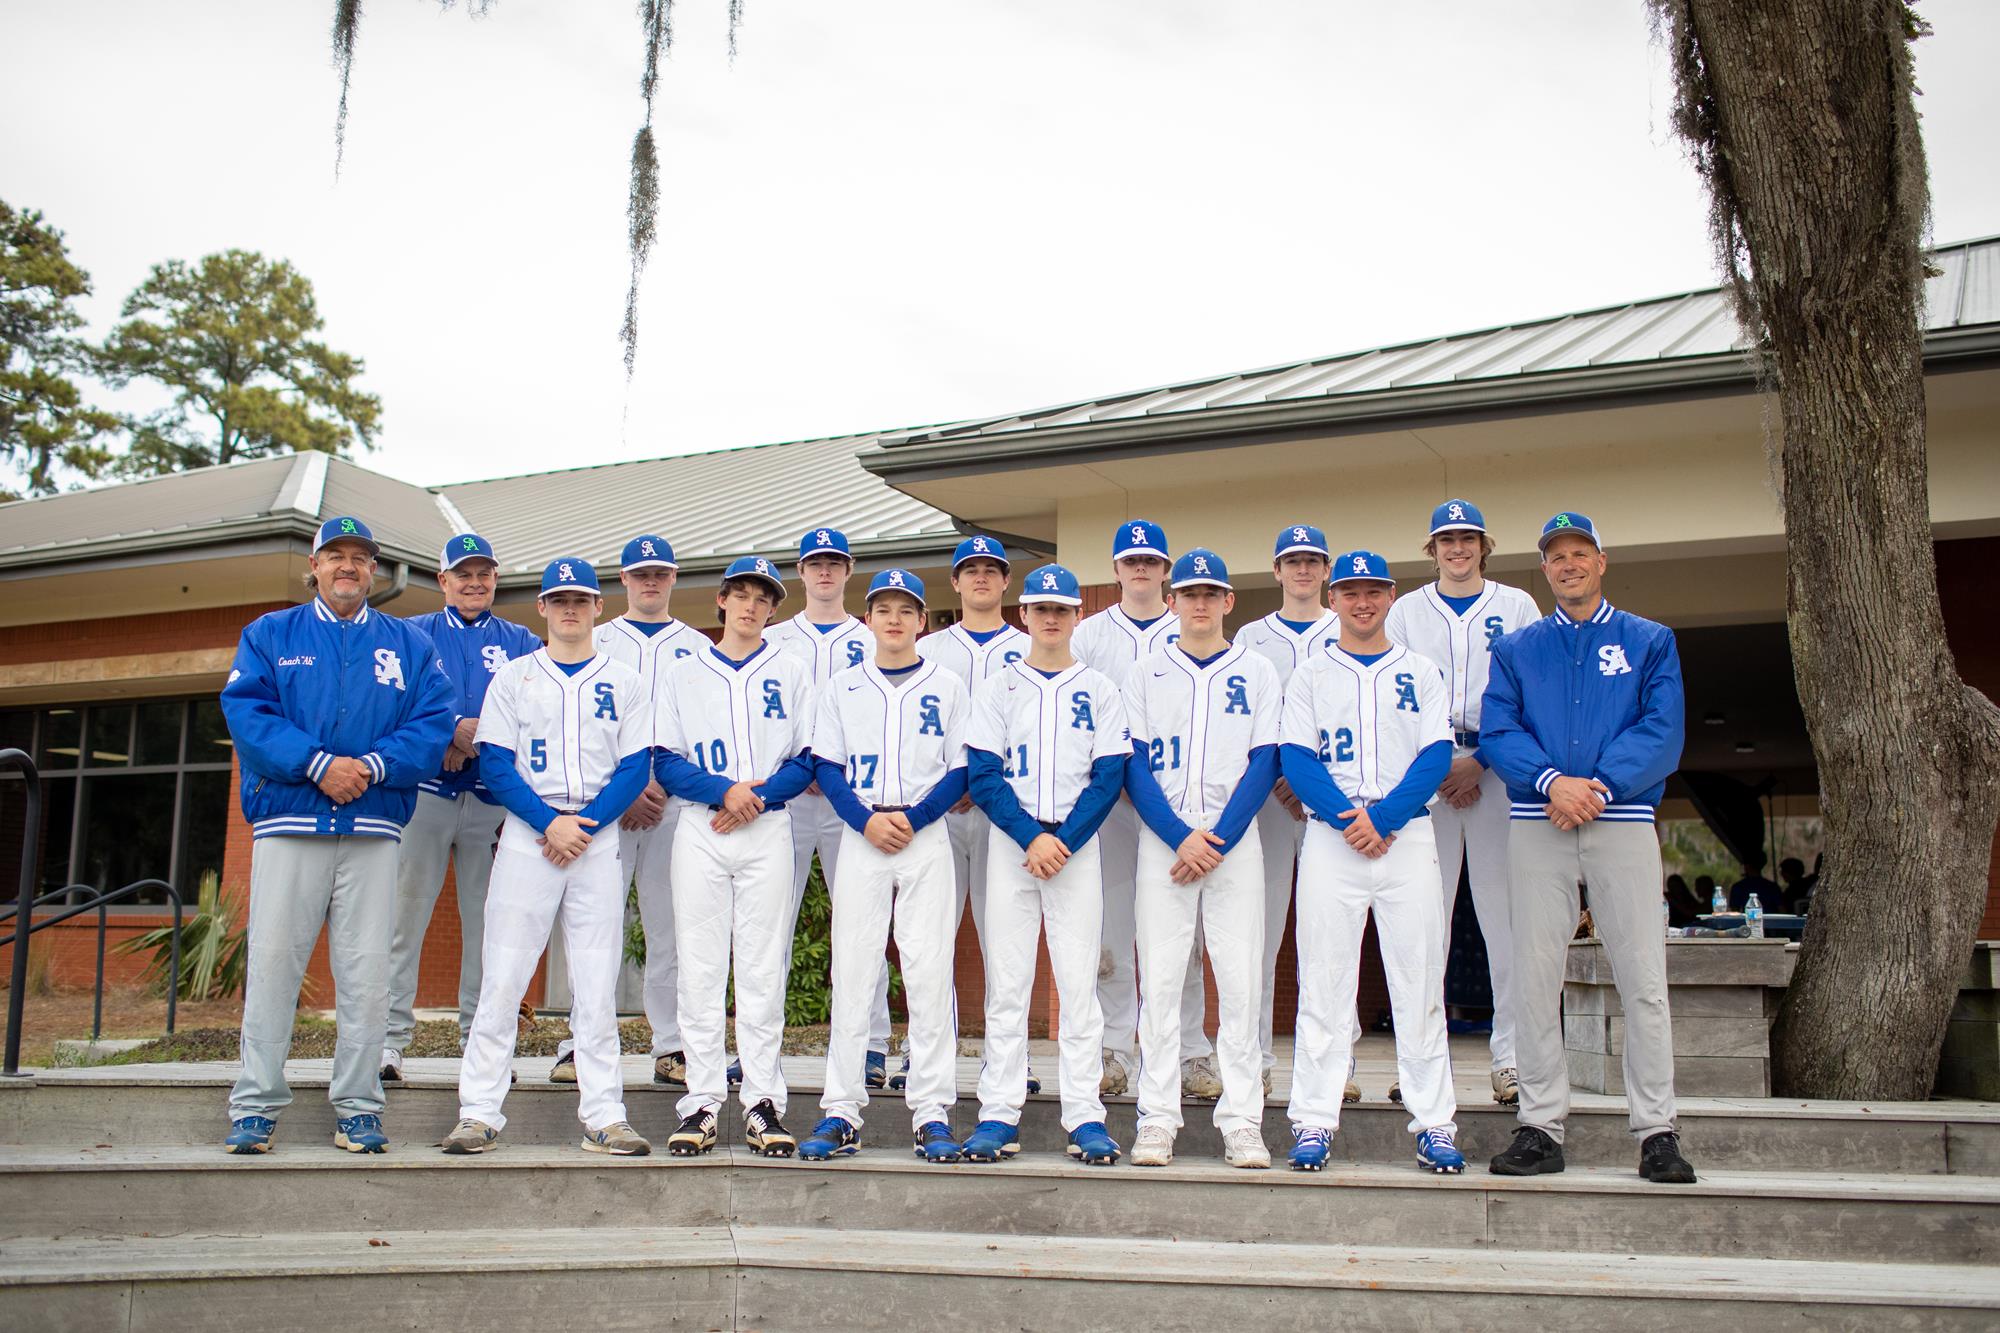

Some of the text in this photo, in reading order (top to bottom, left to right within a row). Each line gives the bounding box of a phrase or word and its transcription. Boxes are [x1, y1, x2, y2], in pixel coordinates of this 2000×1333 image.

[1448, 504, 1466, 521] SA
[1556, 513, 1573, 528] SA
[341, 518, 359, 534] SA
[1131, 526, 1149, 545] SA
[1293, 527, 1310, 542] SA
[463, 537, 480, 551] SA
[816, 530, 833, 546] SA
[973, 537, 990, 553] SA
[641, 540, 658, 557] SA
[559, 563, 577, 582] SA
[755, 558, 770, 576] SA
[1194, 556, 1211, 575] SA
[1352, 556, 1371, 575] SA
[889, 570, 906, 587] SA
[1042, 573, 1059, 591] SA
[278, 656, 301, 666] Coach
[374, 648, 406, 691] SA
[1598, 644, 1632, 676] SA
[594, 682, 618, 722] SA
[762, 679, 787, 719] SA
[1225, 675, 1251, 715] SA
[1395, 672, 1419, 713] SA
[919, 694, 945, 737] SA
[1071, 691, 1095, 732] SA
[1151, 735, 1180, 772] 21
[1319, 727, 1354, 763] 22
[530, 738, 548, 773] 5
[694, 738, 728, 773] 10
